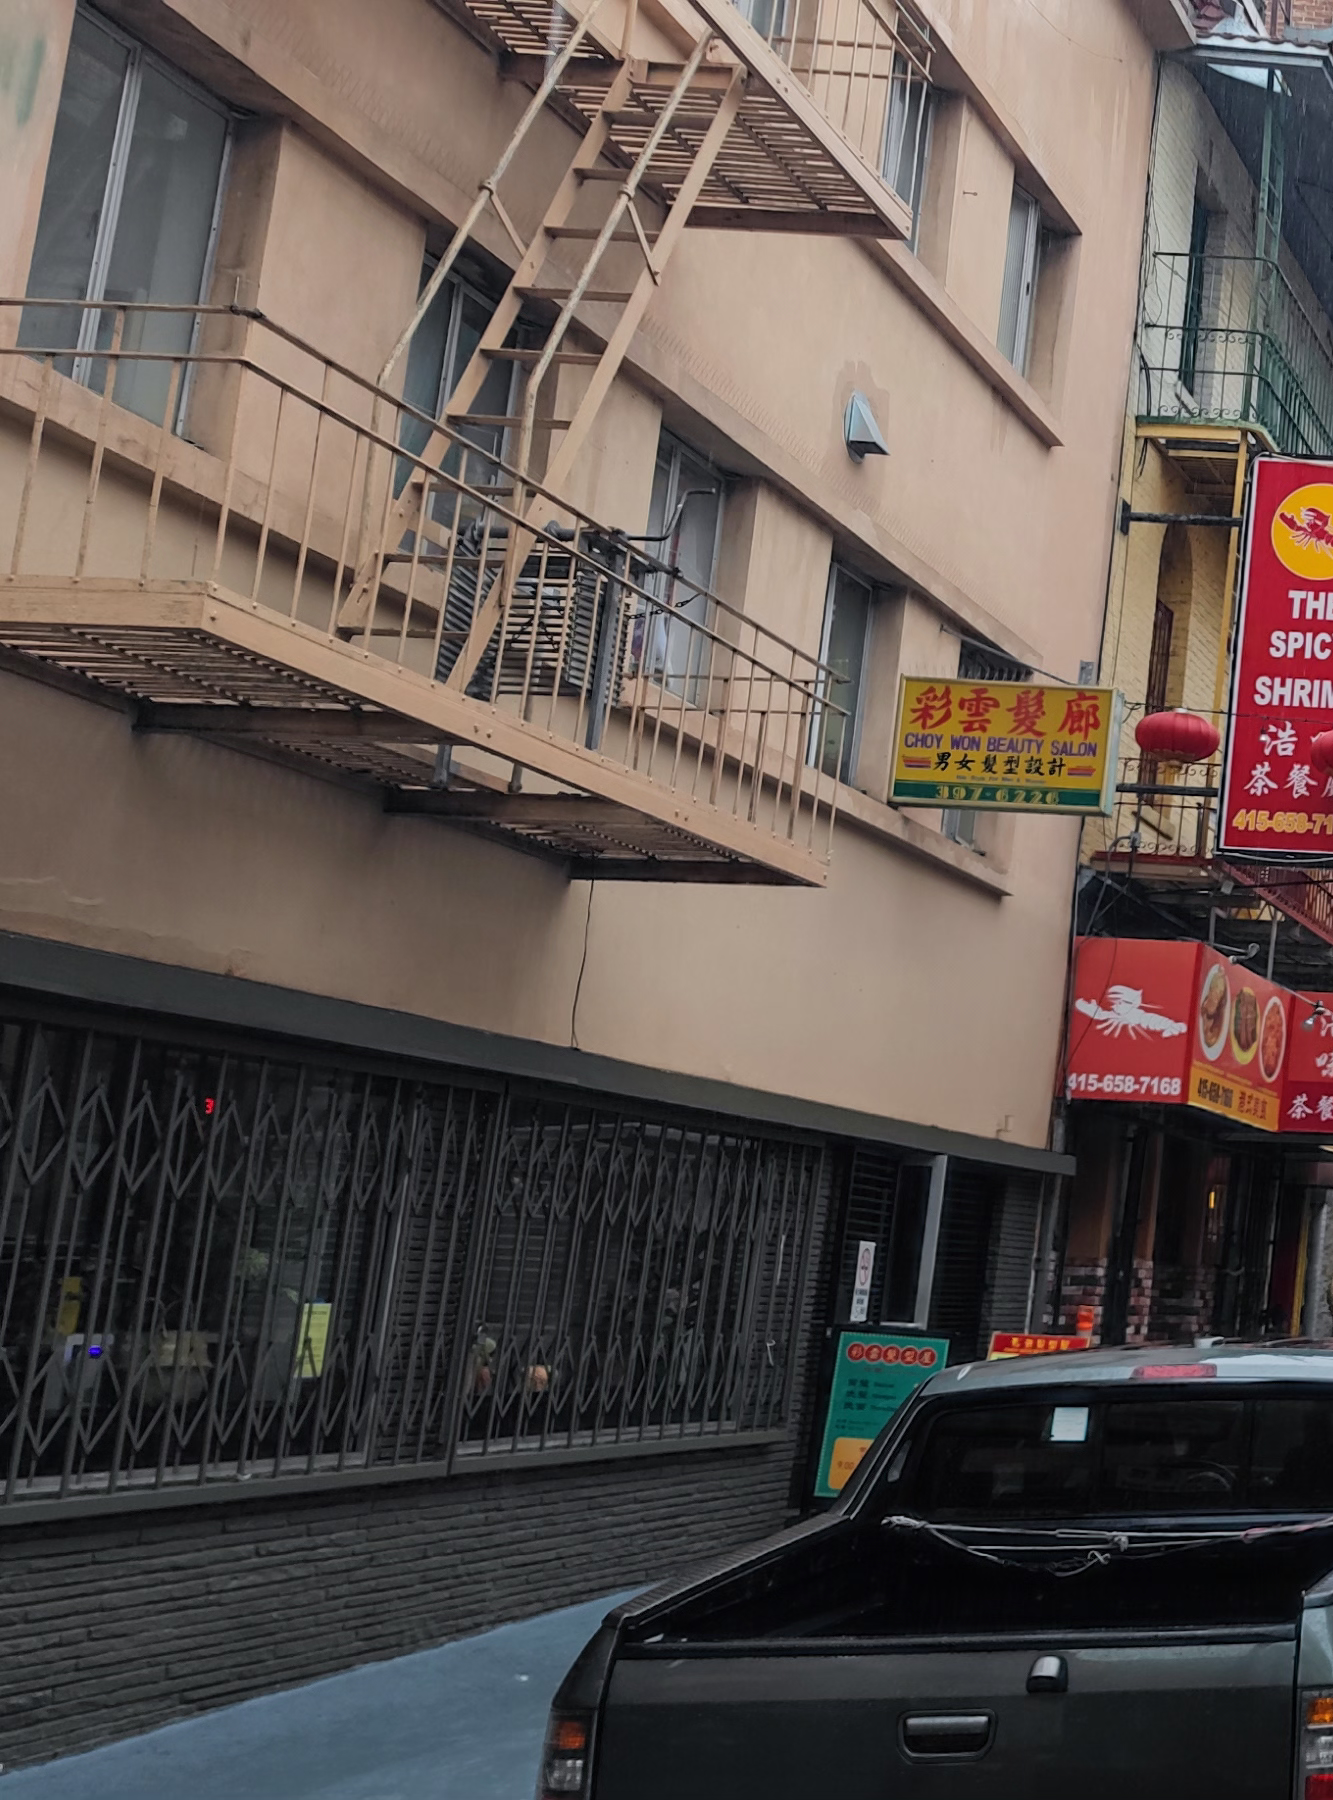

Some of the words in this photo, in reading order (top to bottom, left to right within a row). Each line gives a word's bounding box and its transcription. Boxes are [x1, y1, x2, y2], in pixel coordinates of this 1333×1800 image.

[908, 685, 1101, 741] 彩雲髮廊
[904, 732, 944, 749] CHOY
[950, 734, 980, 752] WON
[986, 736, 1044, 755] BEAUTY
[1051, 739, 1098, 758] SALON
[933, 752, 1066, 777] 男女髮型設計
[1068, 1072, 1181, 1096] 415-658-7168
